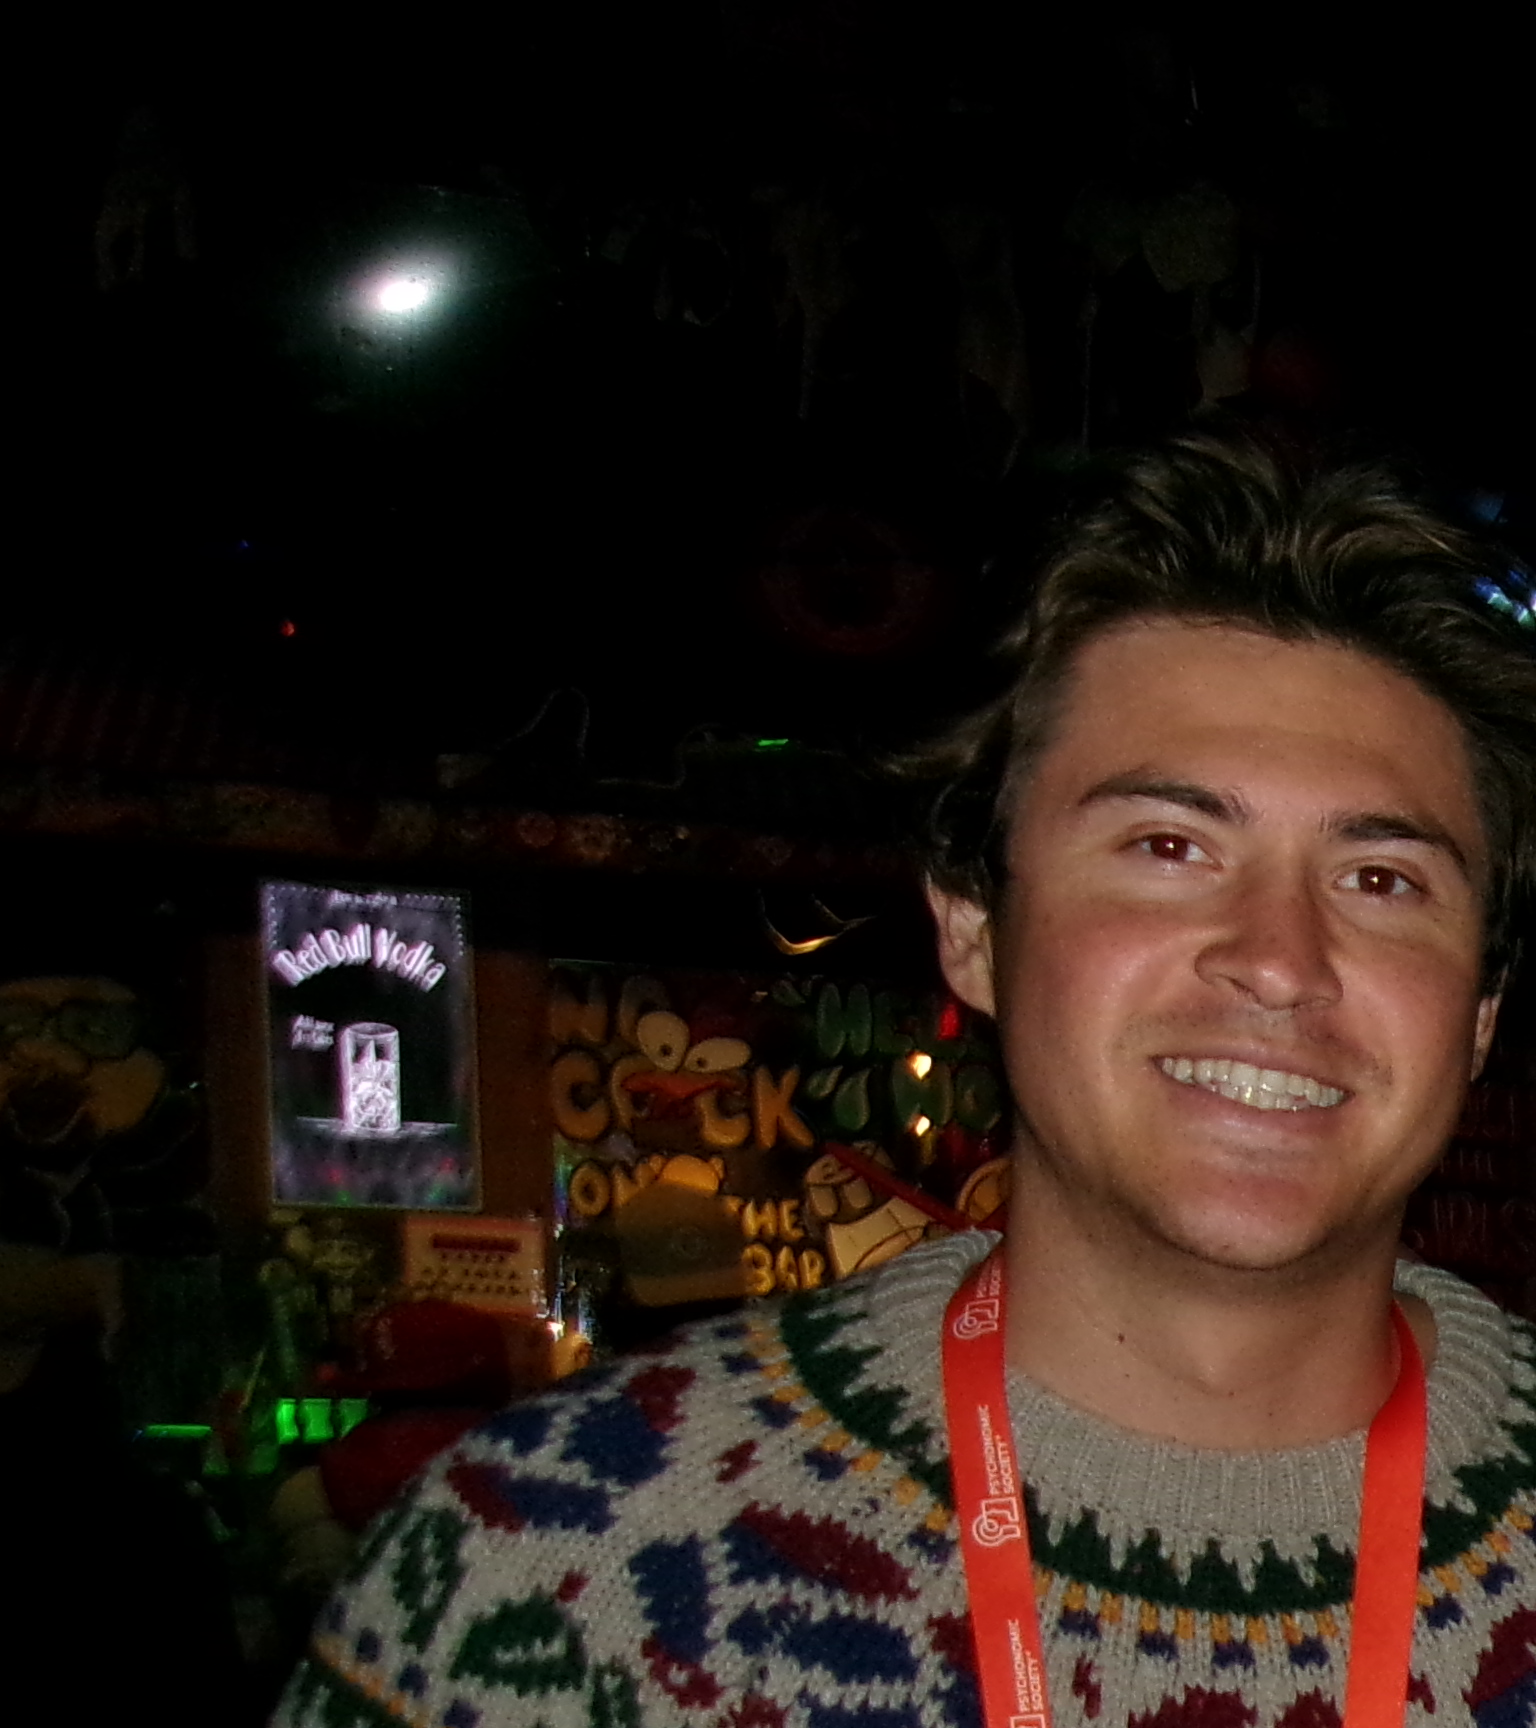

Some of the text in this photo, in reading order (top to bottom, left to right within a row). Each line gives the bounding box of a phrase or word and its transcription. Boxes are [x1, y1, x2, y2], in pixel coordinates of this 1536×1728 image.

[319, 923, 372, 968] Bull
[374, 927, 447, 993] Vodka
[1007, 1618, 1026, 1713] PSYCHONOMIC
